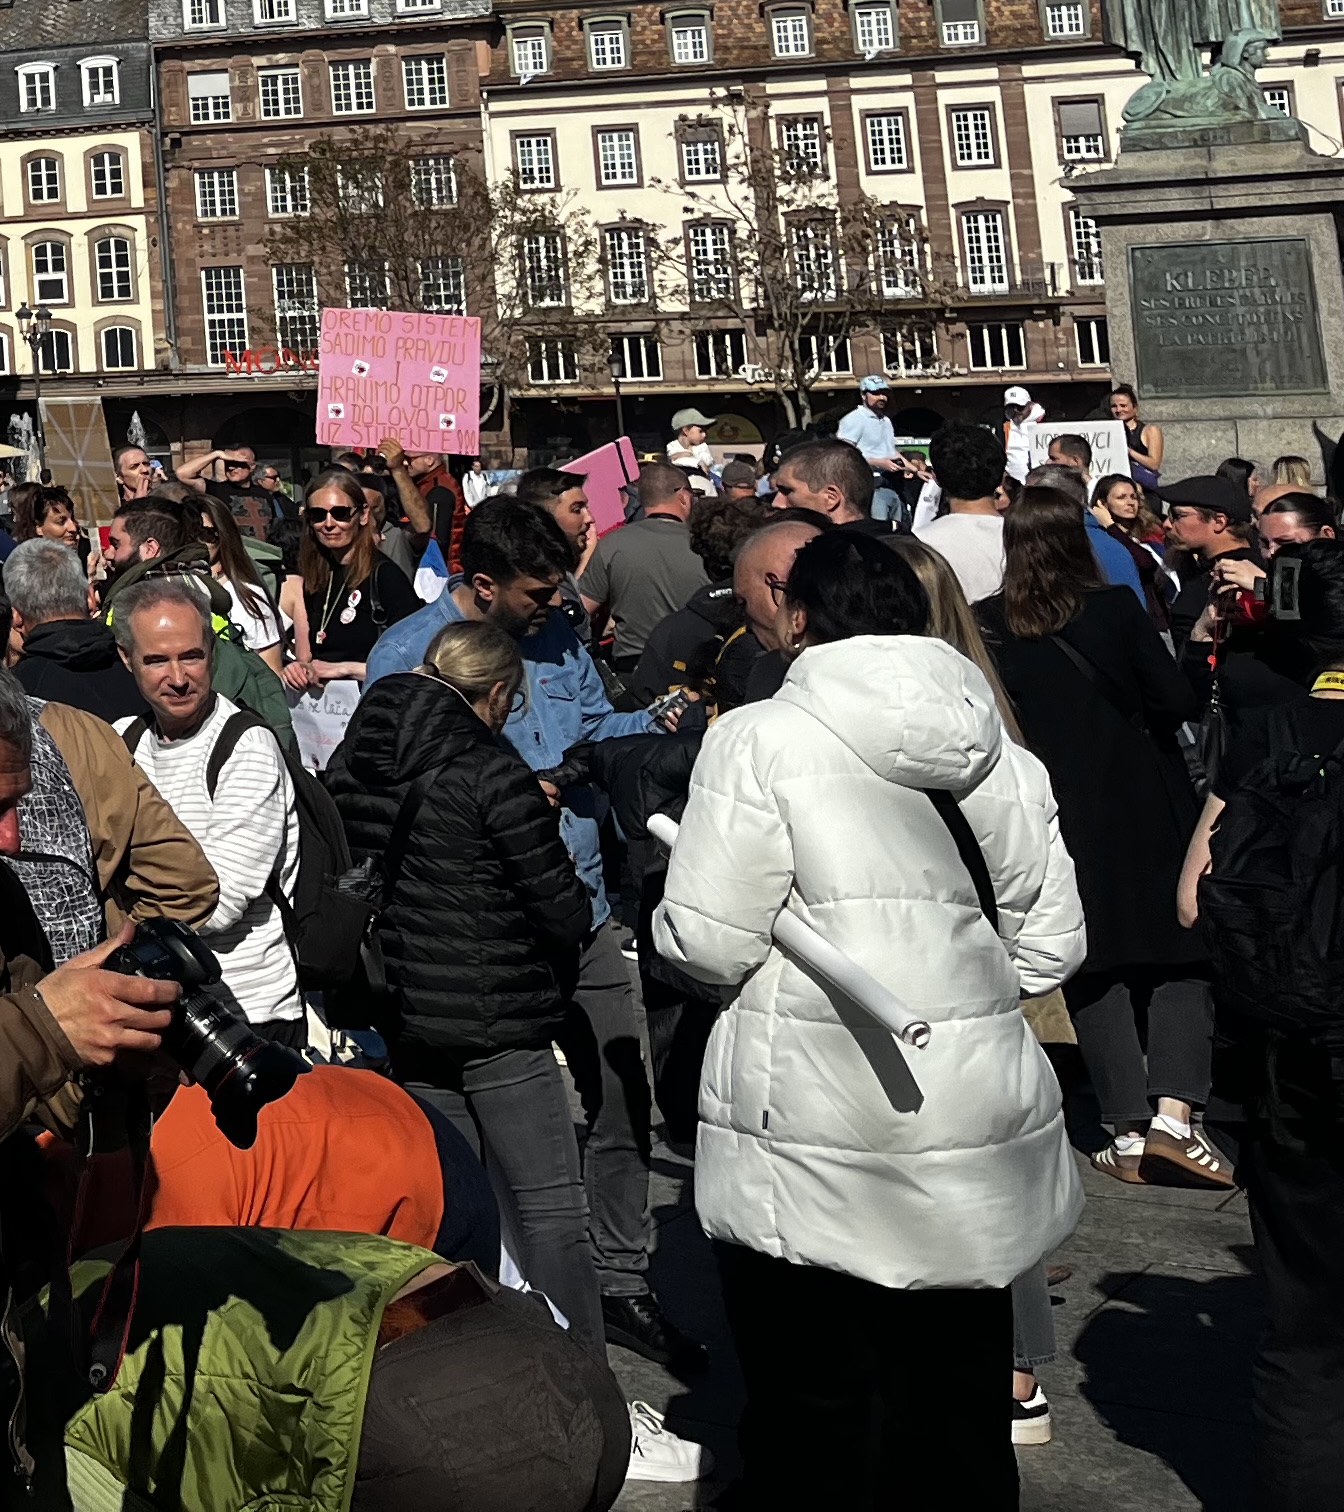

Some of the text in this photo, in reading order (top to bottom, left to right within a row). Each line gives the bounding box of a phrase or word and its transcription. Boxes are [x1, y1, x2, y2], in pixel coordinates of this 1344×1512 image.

[324, 310, 479, 338] OREMO SISTEM
[321, 331, 466, 365] SADIMO PRAVDU
[320, 374, 468, 414] HRANIMO OTPOR
[351, 403, 430, 429] DOLOVO
[320, 422, 342, 444] UZ
